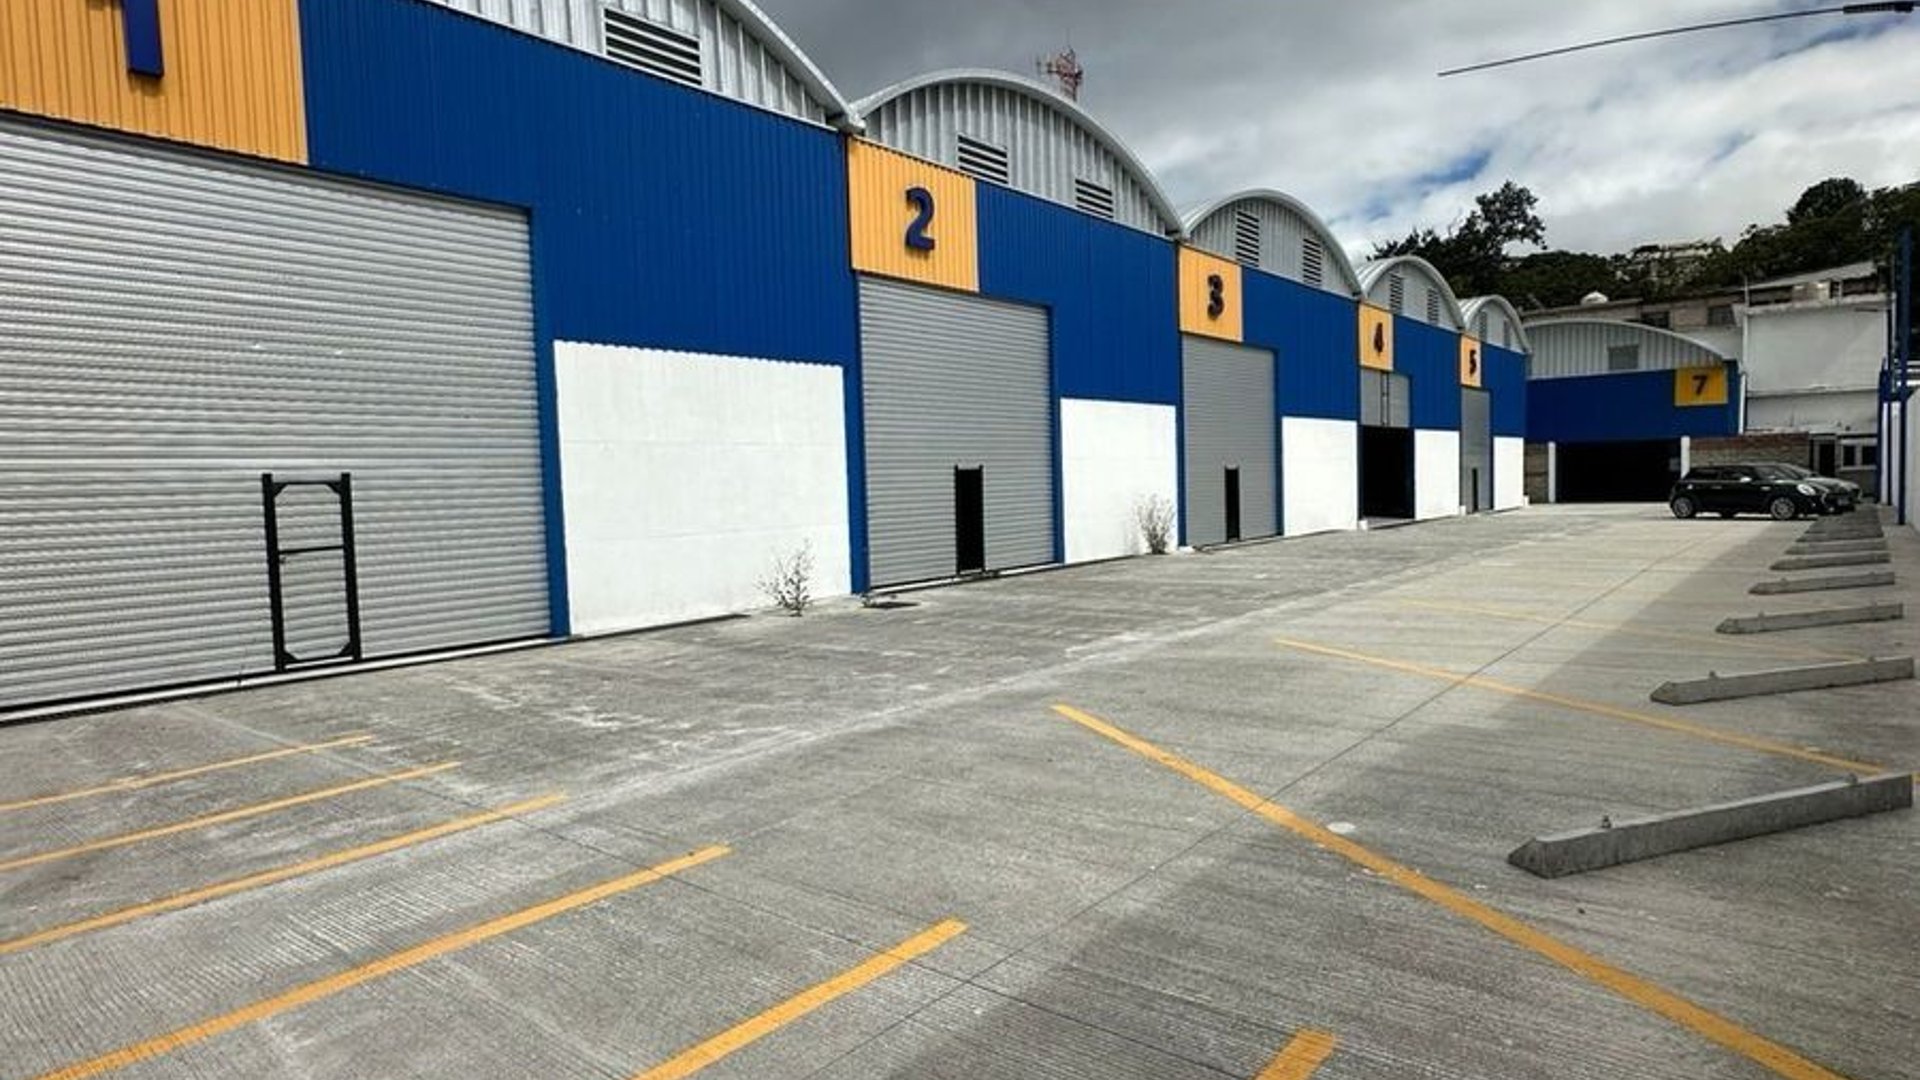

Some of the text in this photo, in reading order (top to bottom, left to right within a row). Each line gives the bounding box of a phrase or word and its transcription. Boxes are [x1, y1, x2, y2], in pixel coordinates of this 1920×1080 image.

[903, 187, 935, 252] 2
[1207, 274, 1224, 320] 3
[1374, 322, 1384, 353] 4
[1470, 349, 1477, 375] 5
[1692, 375, 1708, 396] 7
